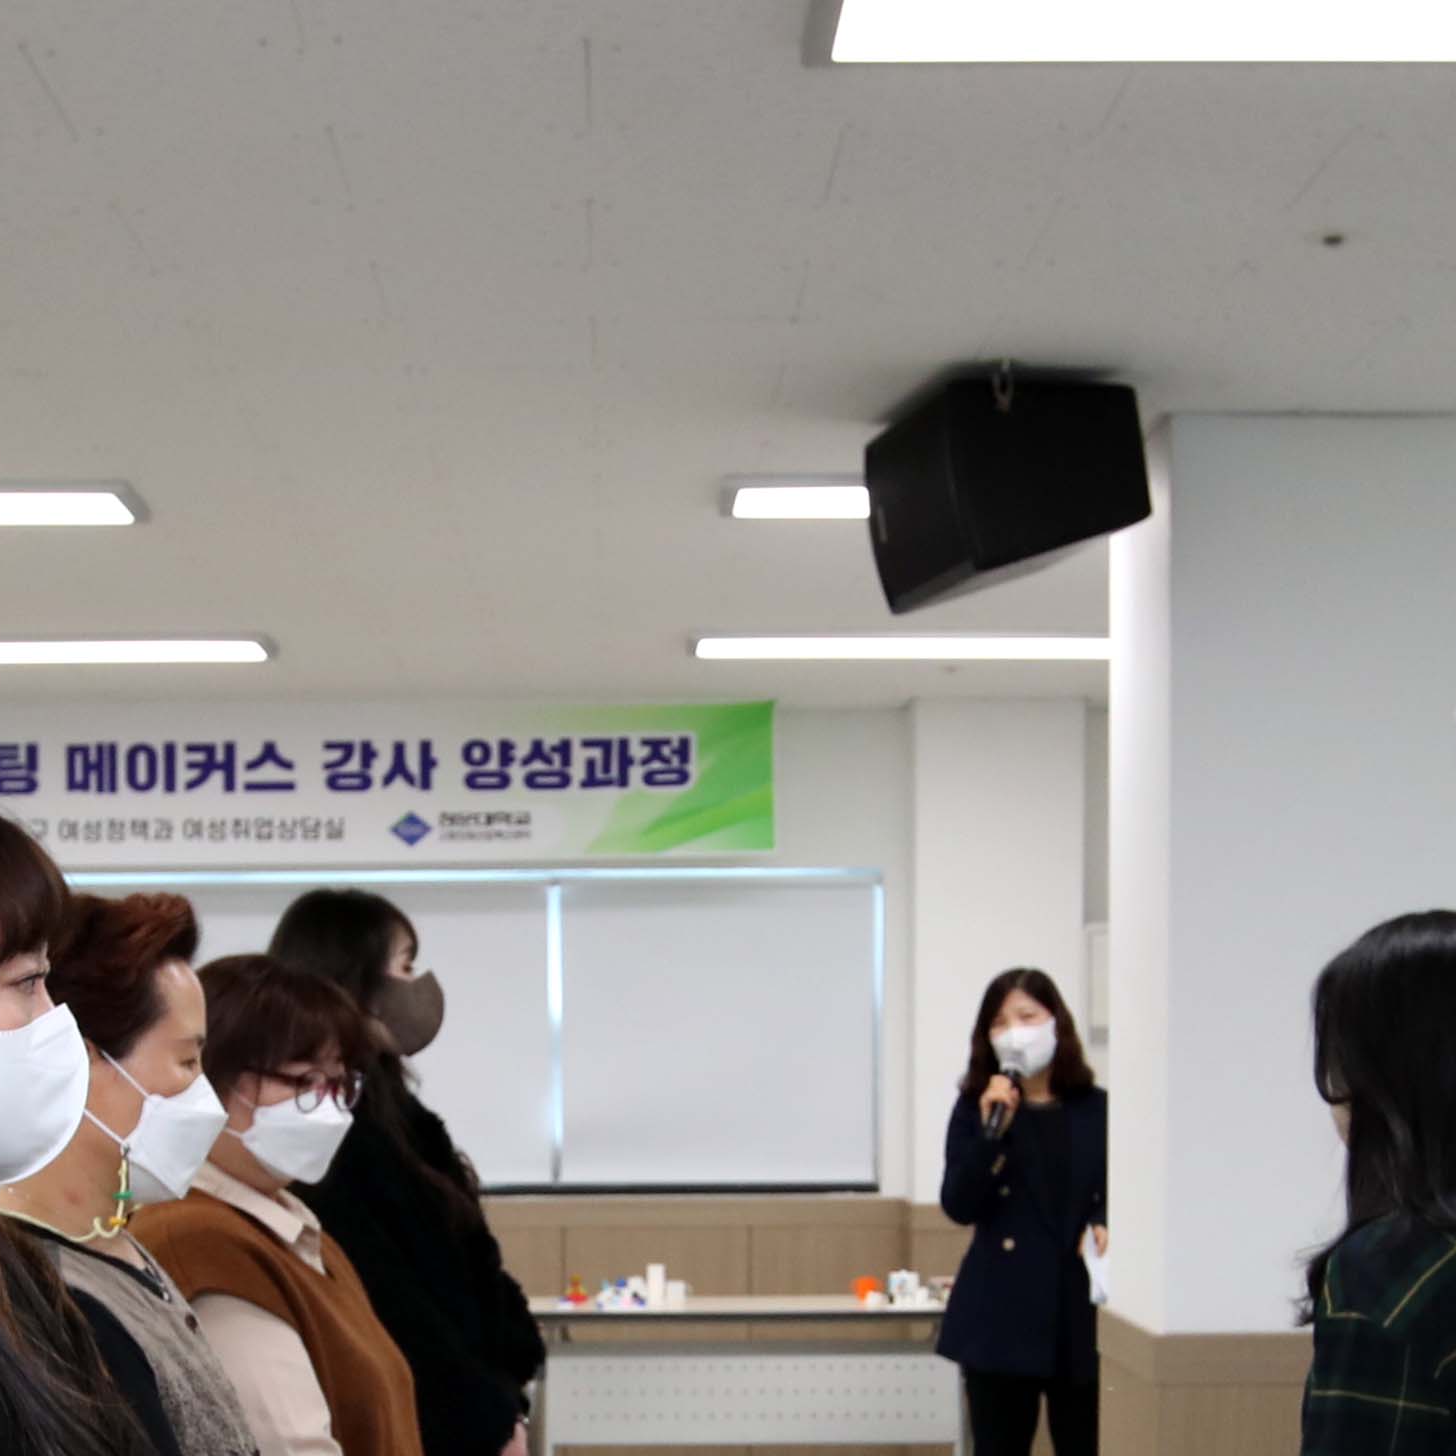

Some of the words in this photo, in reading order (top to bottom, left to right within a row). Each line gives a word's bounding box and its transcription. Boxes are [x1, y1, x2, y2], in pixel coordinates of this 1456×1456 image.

[65, 741, 296, 793] 메이커스
[322, 739, 437, 792] 강사
[461, 736, 691, 791] 양성과정
